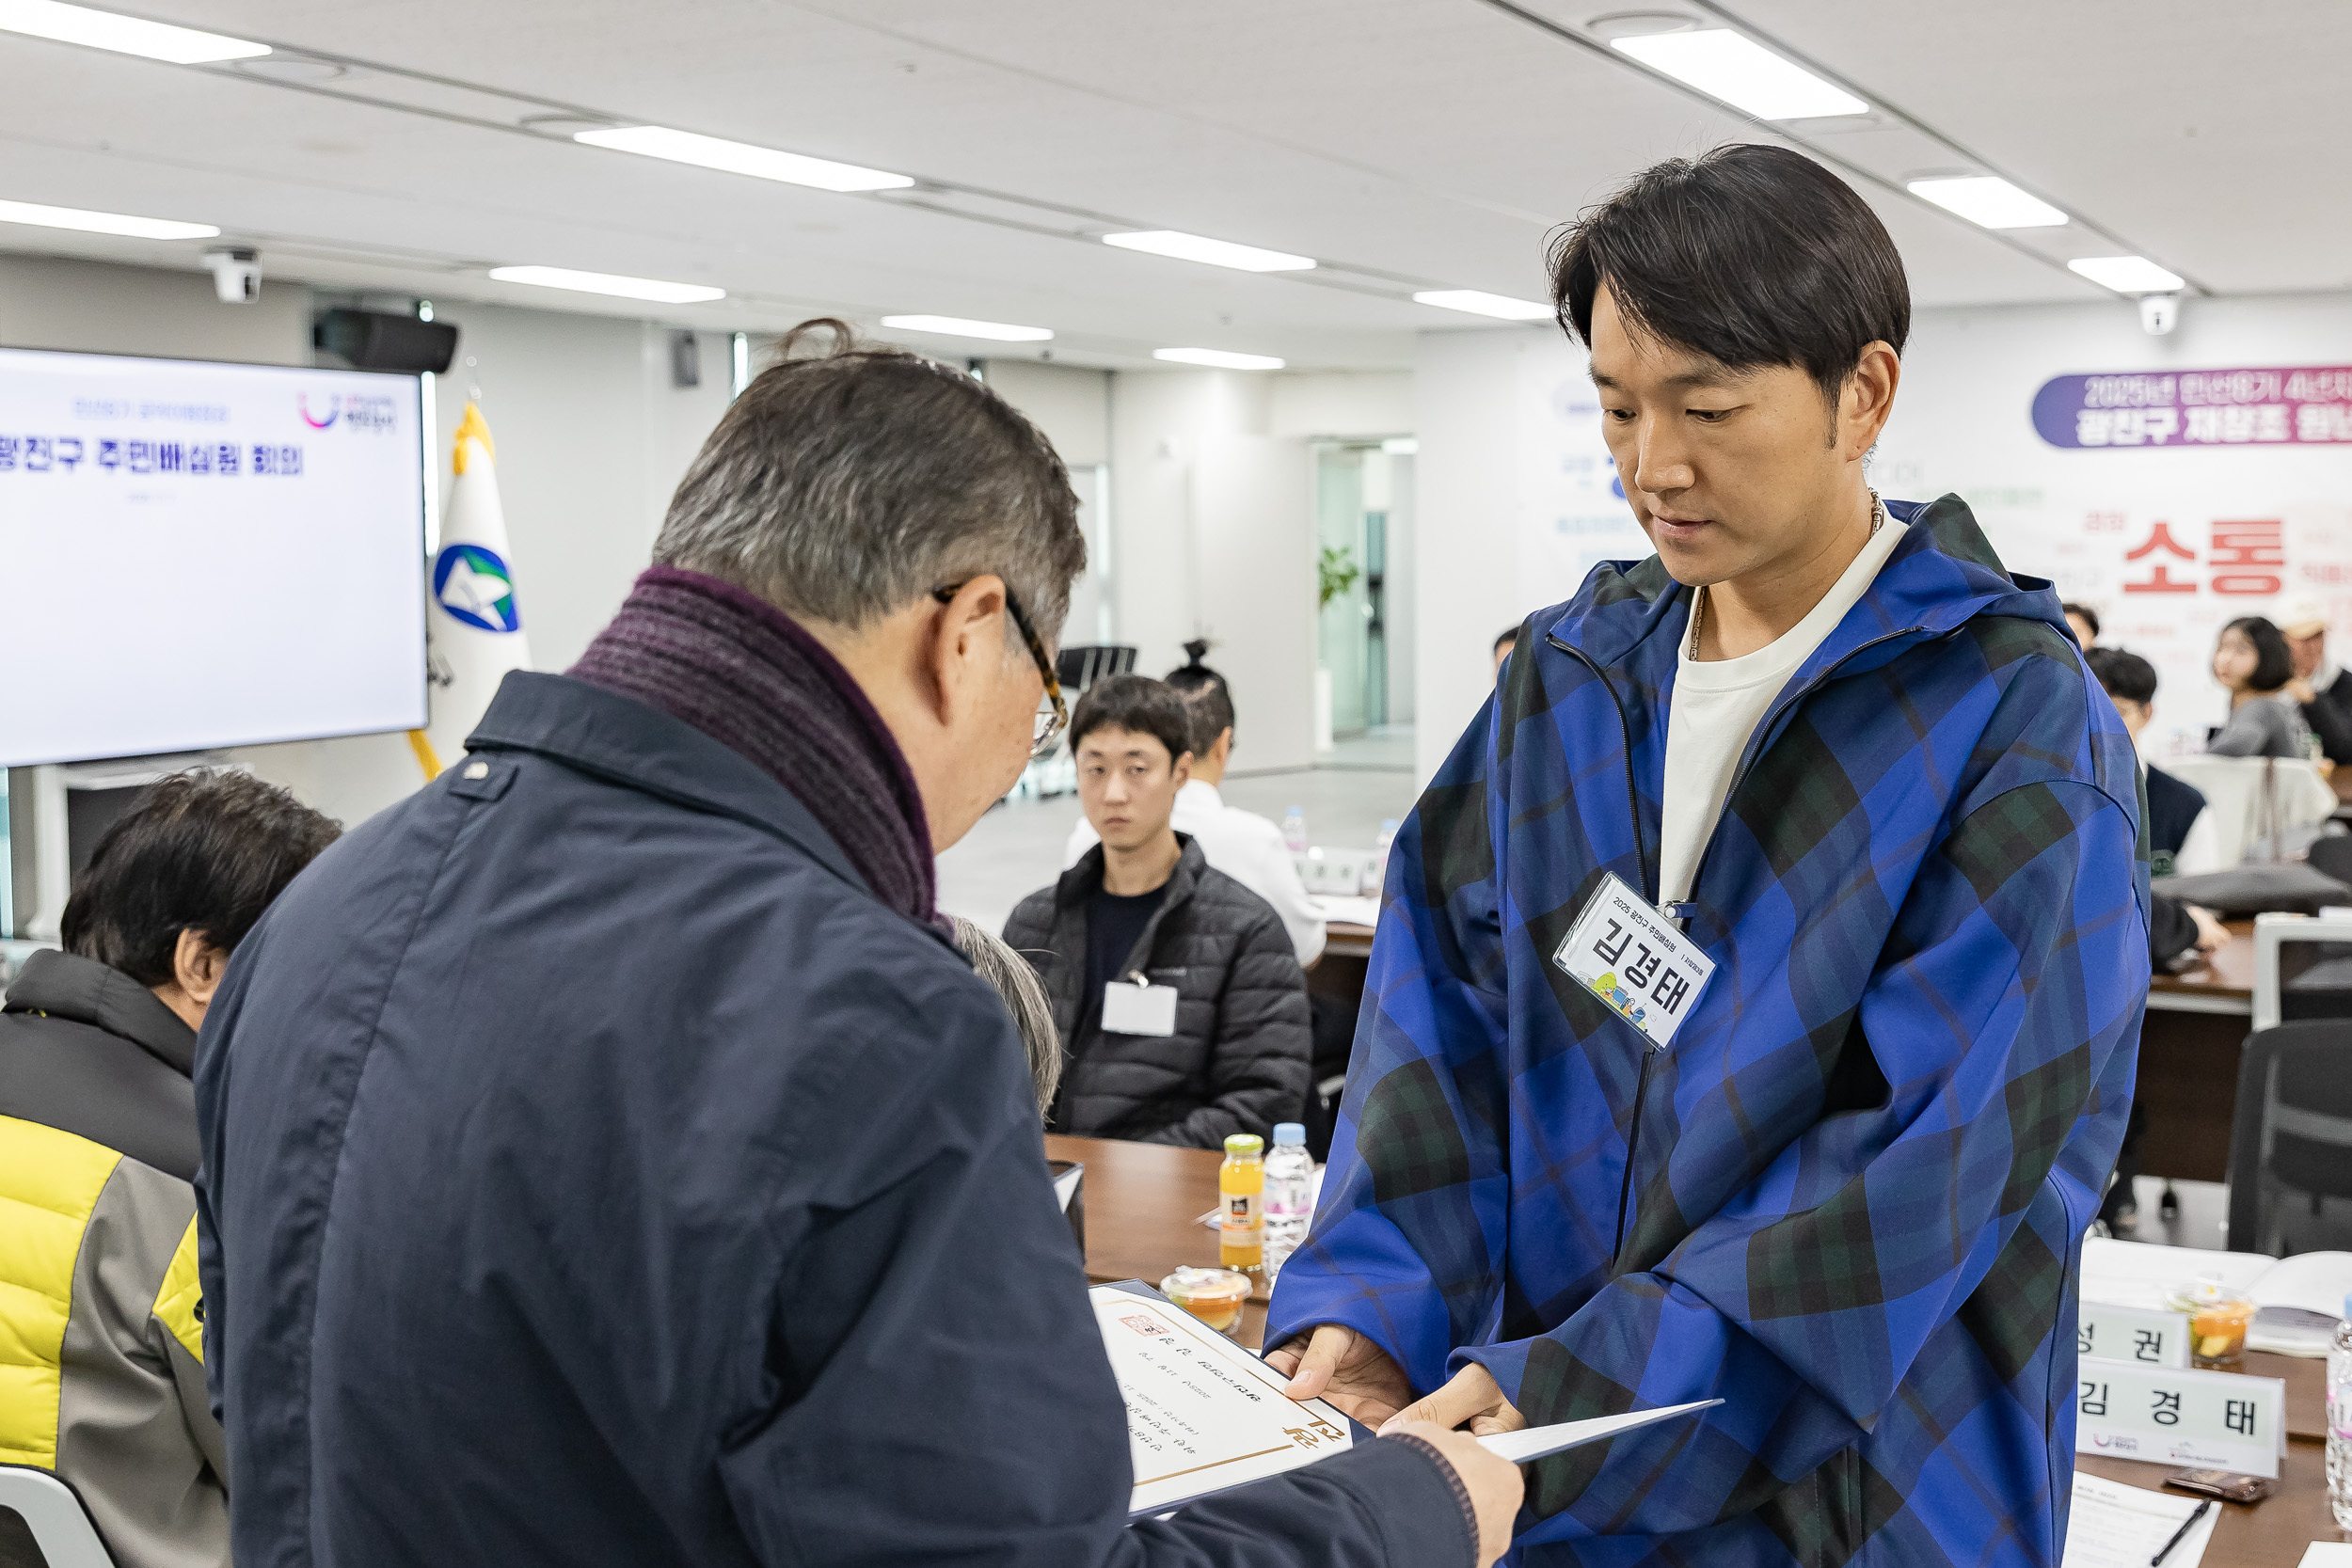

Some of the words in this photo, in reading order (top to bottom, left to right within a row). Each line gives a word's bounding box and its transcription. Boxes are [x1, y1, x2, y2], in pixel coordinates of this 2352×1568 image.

[2076, 408, 2180, 445] 광진구
[2123, 520, 2283, 594] 소통
[1613, 897, 1631, 914] 2025
[1629, 910, 1649, 928] 광진구
[1648, 925, 1677, 953] 주민배심원
[1592, 918, 1691, 1016] 김경태
